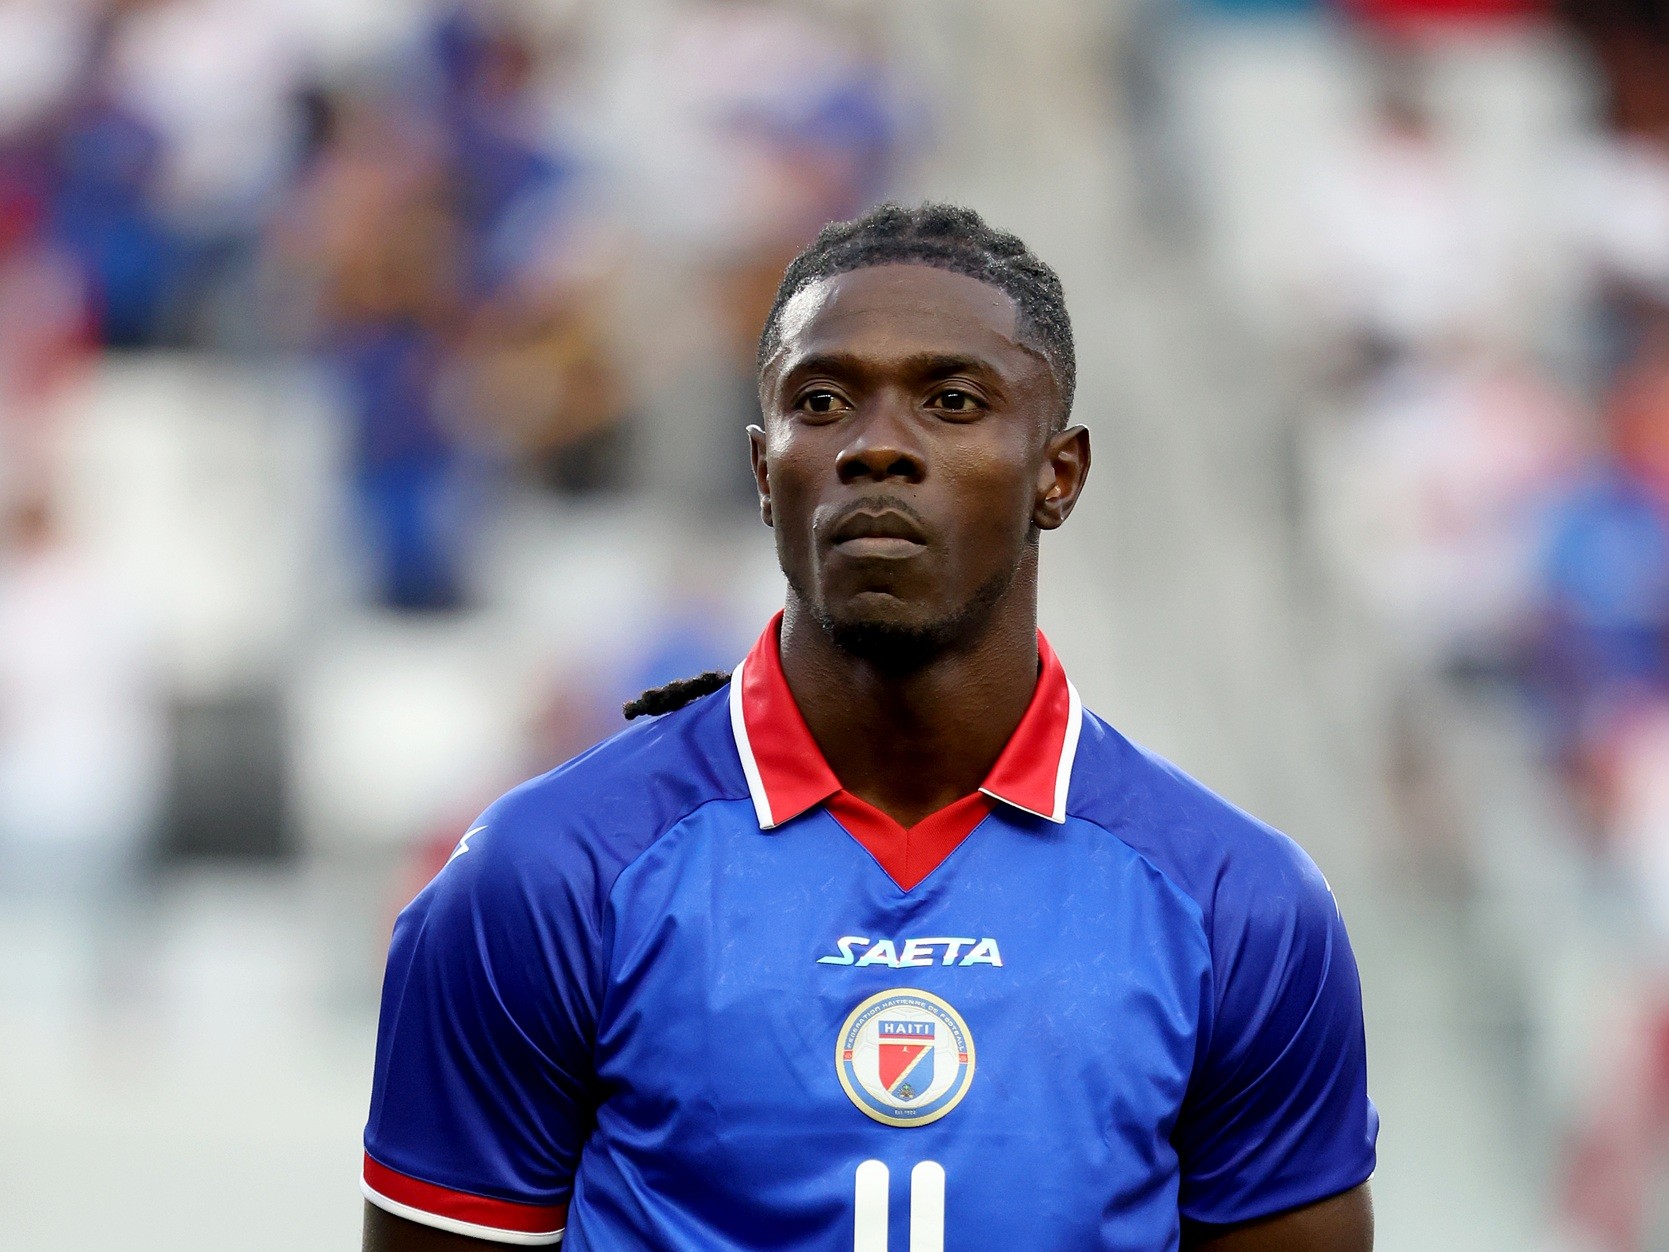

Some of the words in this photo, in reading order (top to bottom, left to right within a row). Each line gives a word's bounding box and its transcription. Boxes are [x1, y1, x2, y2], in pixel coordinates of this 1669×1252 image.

[816, 936, 1004, 968] SAETA
[884, 1023, 929, 1034] HAITI
[928, 1005, 939, 1015] DE
[940, 1013, 965, 1051] FOOTBALL
